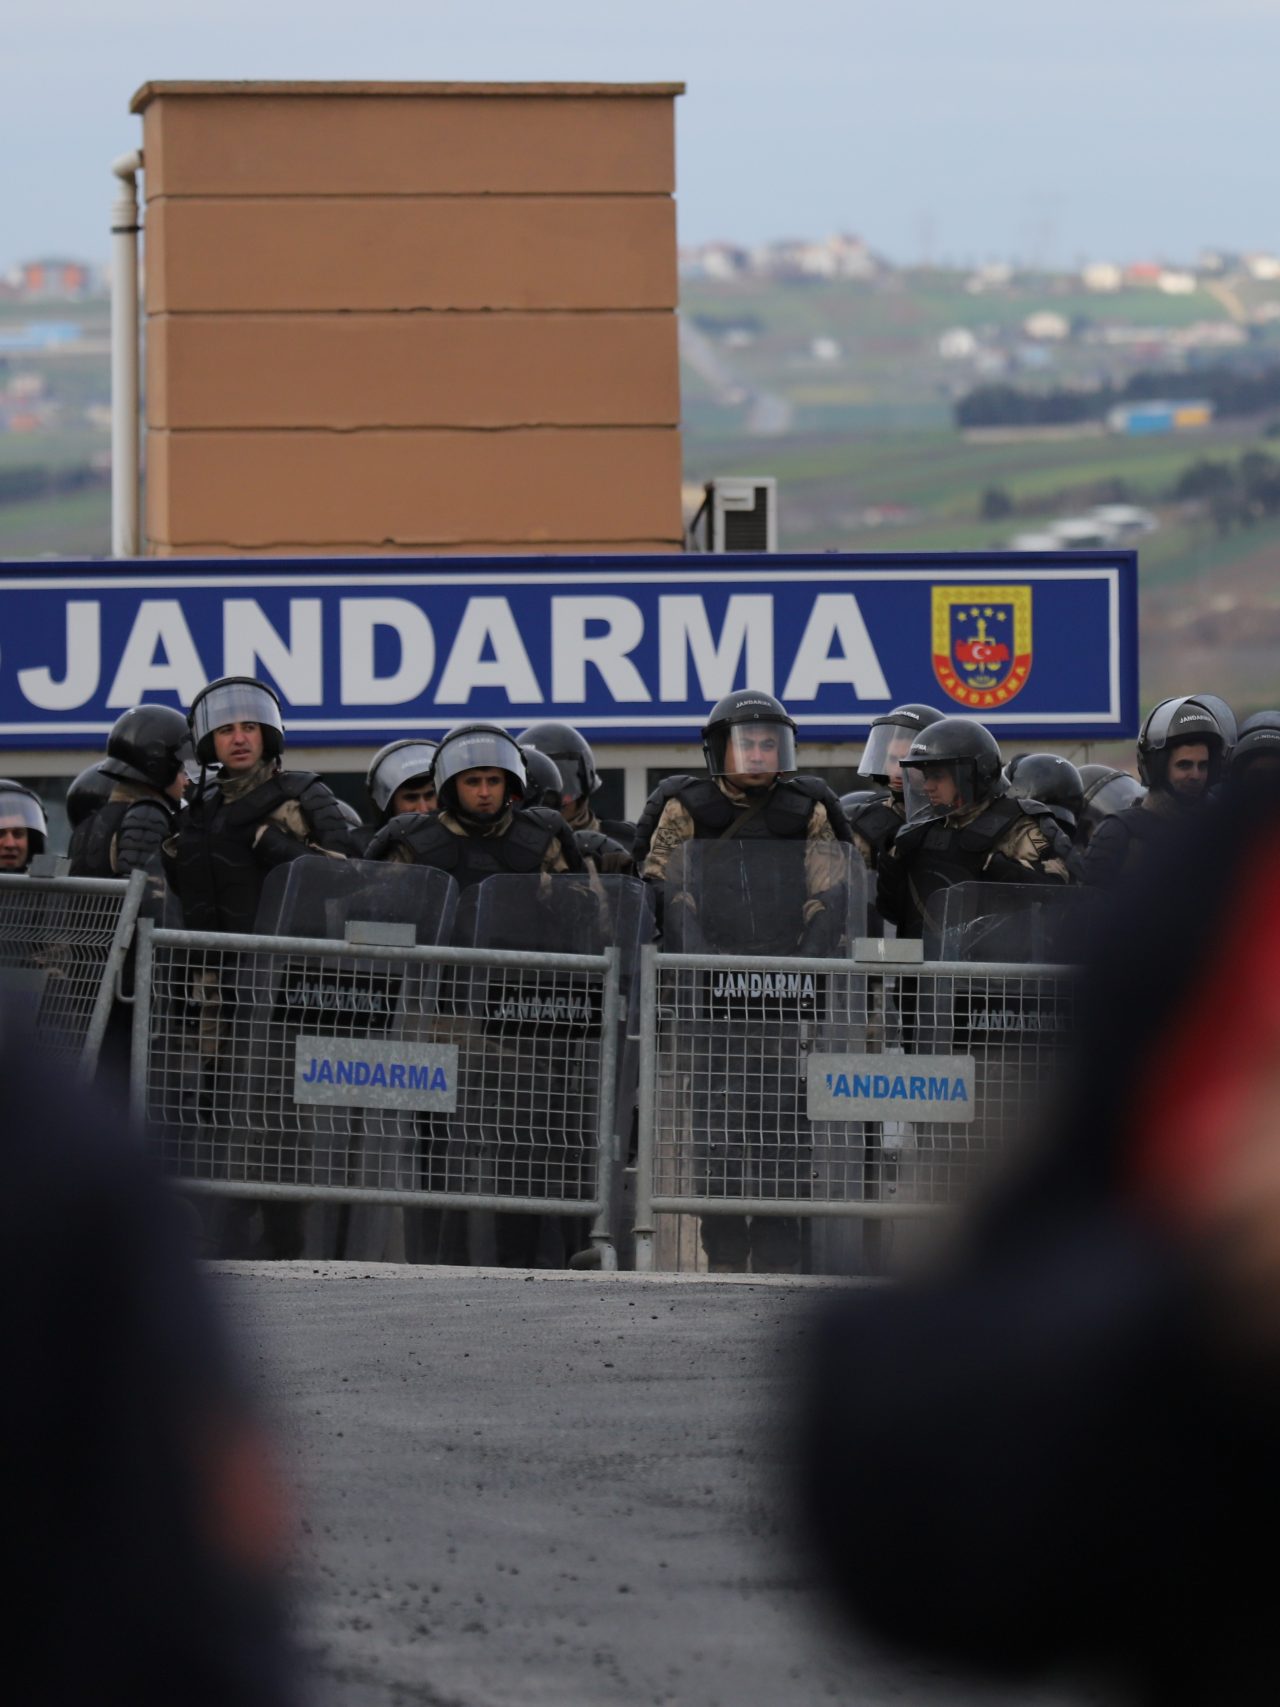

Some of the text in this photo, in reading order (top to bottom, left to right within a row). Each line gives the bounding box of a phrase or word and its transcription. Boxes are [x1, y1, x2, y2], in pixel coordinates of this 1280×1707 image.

[17, 593, 892, 711] JANDARMA
[938, 665, 1026, 705] JANDARMA
[713, 973, 816, 998] JANDARMA
[494, 996, 592, 1020] JANDARMA
[302, 1058, 448, 1092] JANDARMA
